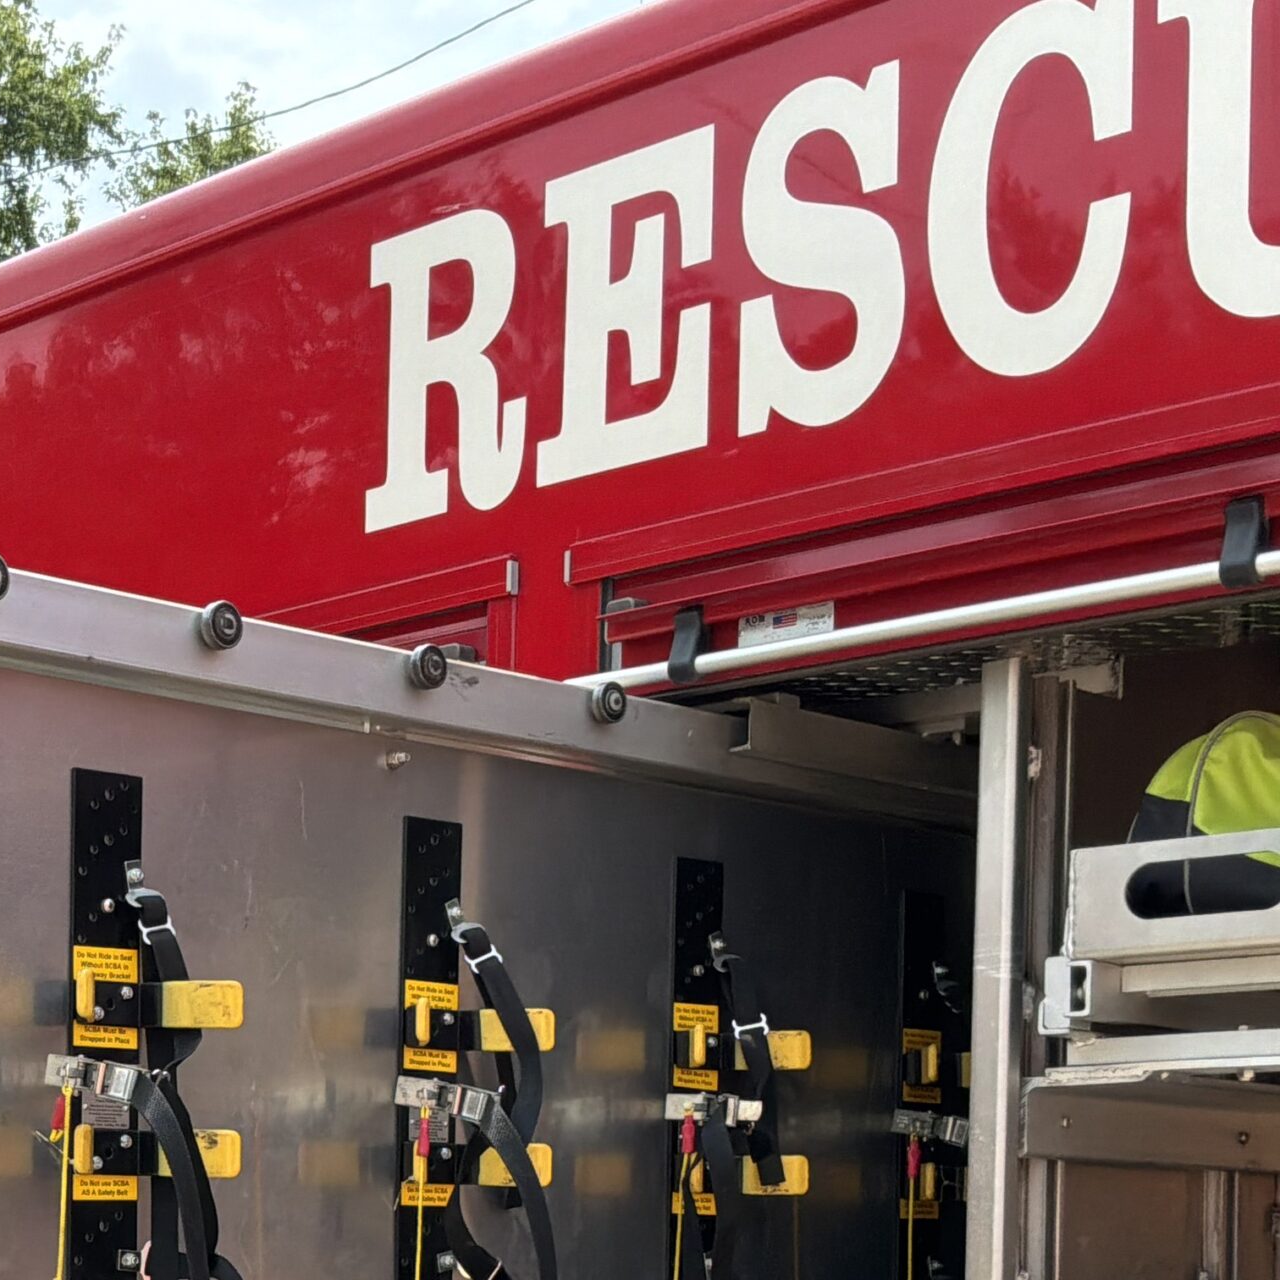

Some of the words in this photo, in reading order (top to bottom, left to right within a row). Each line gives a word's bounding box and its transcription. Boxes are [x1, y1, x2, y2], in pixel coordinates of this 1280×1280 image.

[86, 952, 97, 960] Not
[120, 954, 133, 962] Seat
[80, 961, 104, 969] Without
[79, 1179, 89, 1187] Do
[97, 1189, 116, 1198] Safety
